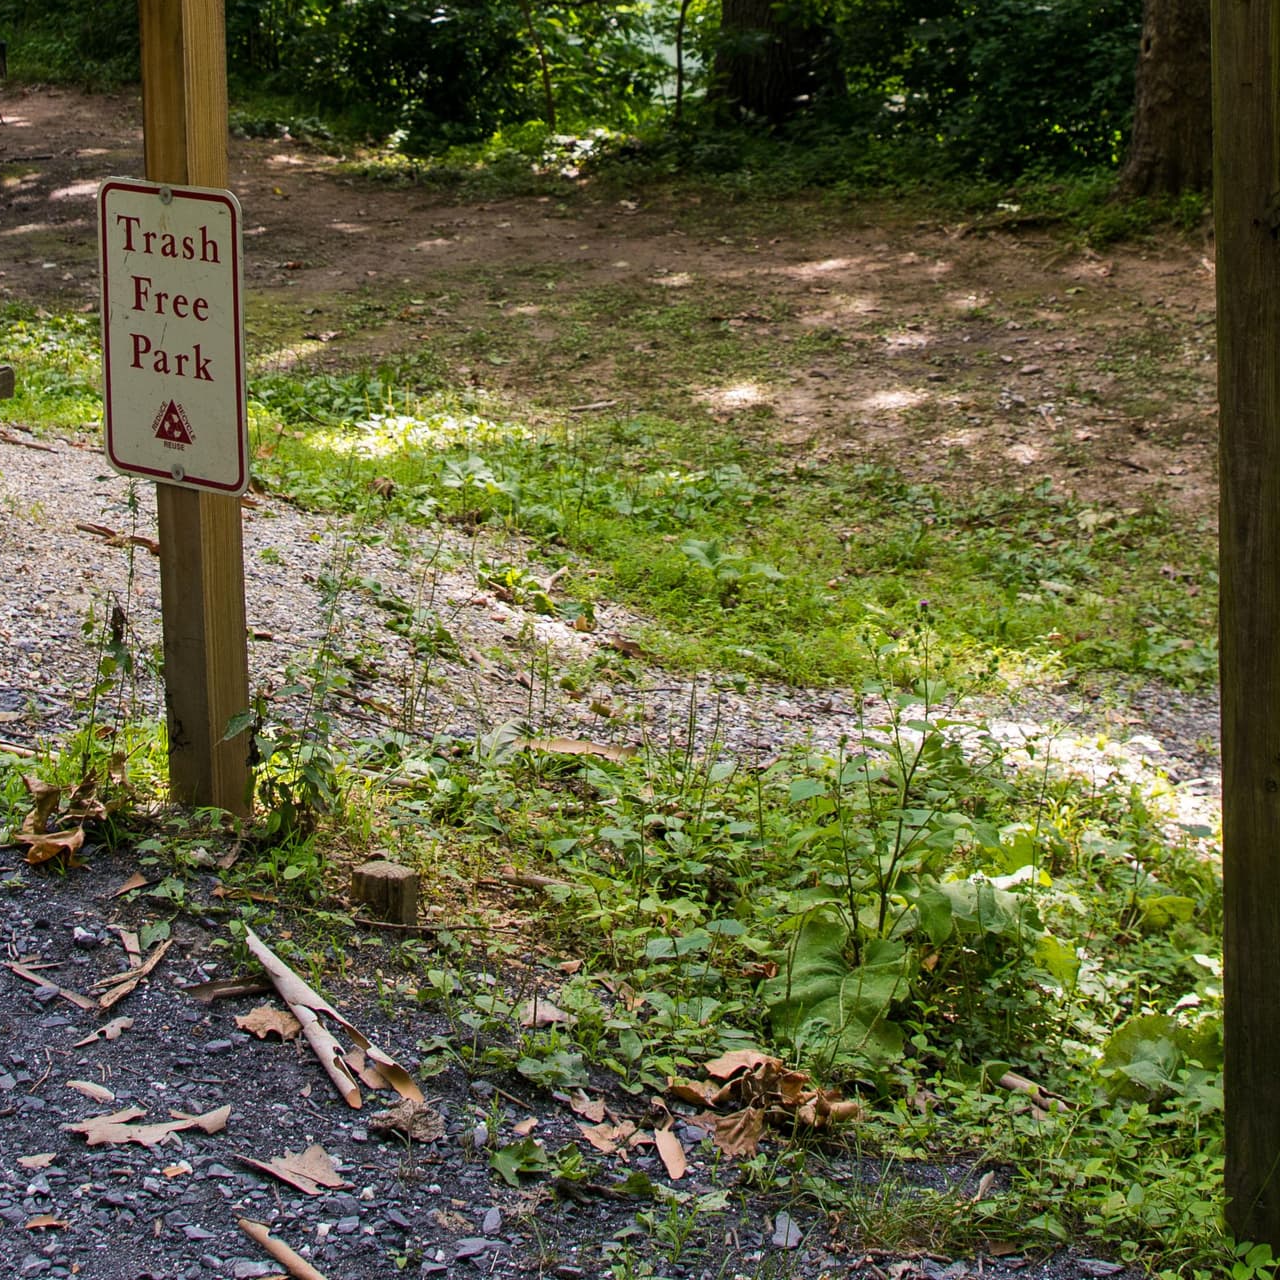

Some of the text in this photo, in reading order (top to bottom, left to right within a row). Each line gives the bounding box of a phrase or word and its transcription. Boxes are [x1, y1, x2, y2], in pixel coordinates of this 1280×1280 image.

[117, 215, 221, 264] Trash
[131, 275, 209, 321] Free
[129, 333, 215, 382] Park
[151, 400, 169, 431] REDUCE
[176, 403, 197, 441] RECYCLE
[163, 440, 185, 451] REUSE
